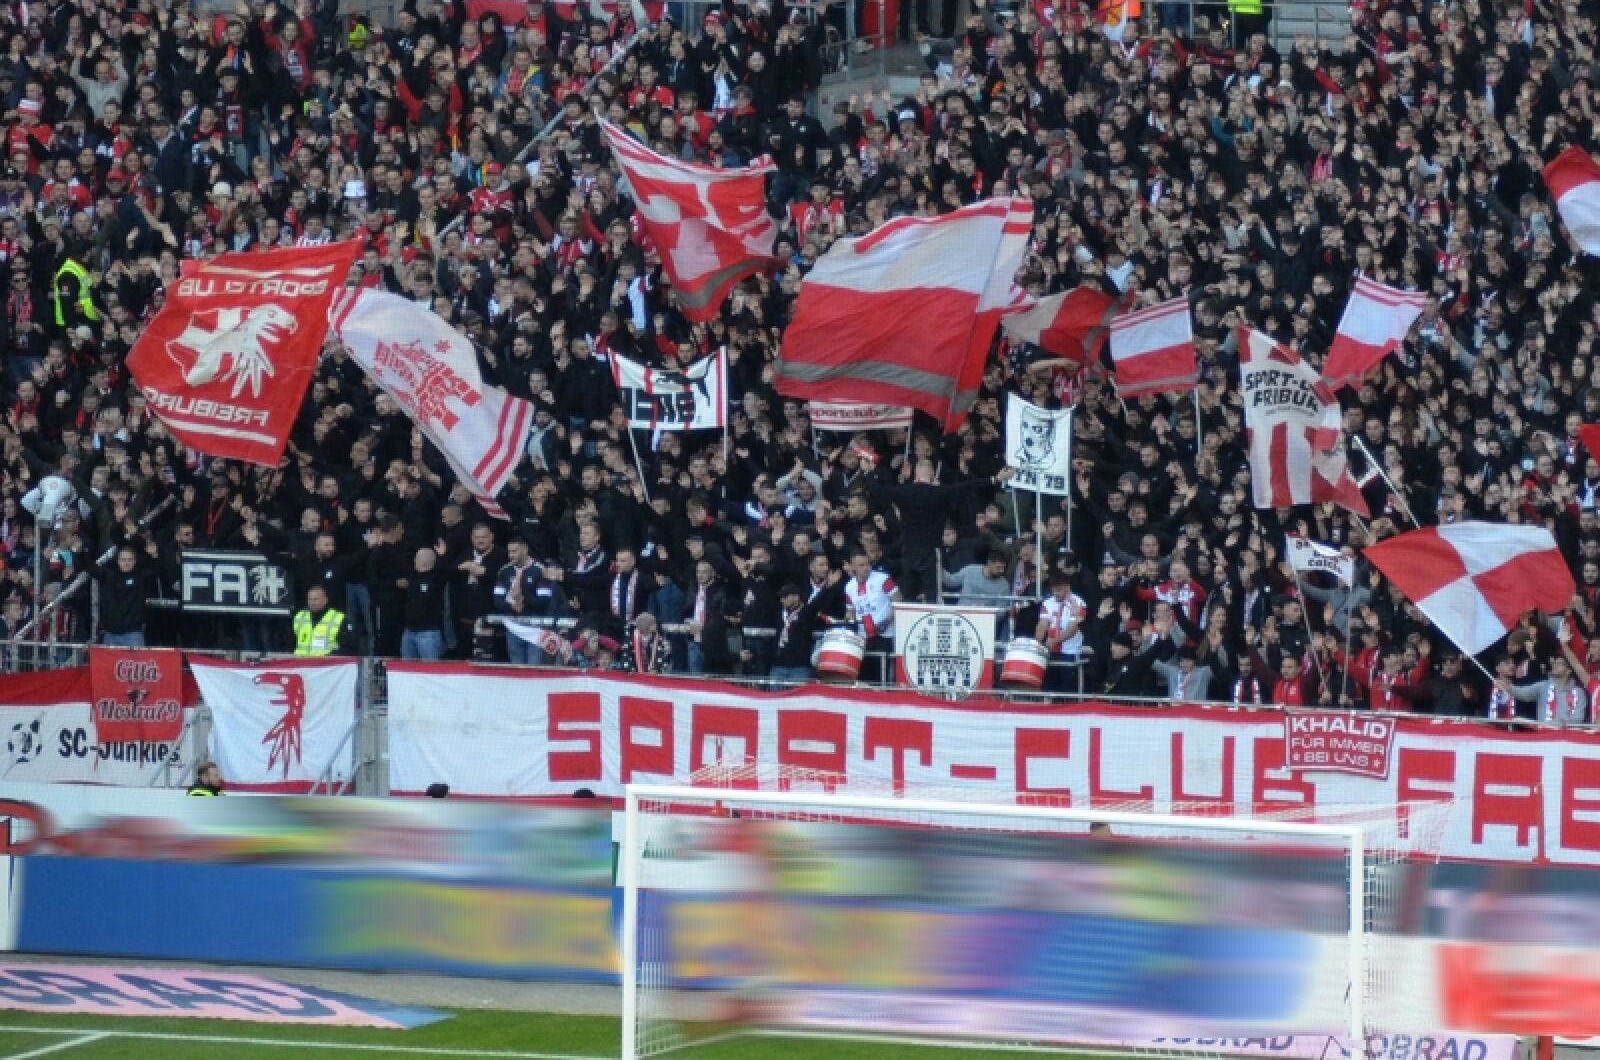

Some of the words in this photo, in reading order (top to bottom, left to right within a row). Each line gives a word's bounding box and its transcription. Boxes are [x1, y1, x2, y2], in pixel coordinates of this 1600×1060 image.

[1291, 716, 1388, 739] KHALID
[1291, 733, 1325, 749] FÜR
[1329, 737, 1385, 756] IMMER
[1303, 751, 1330, 763] BEI
[1333, 751, 1369, 767] UNS
